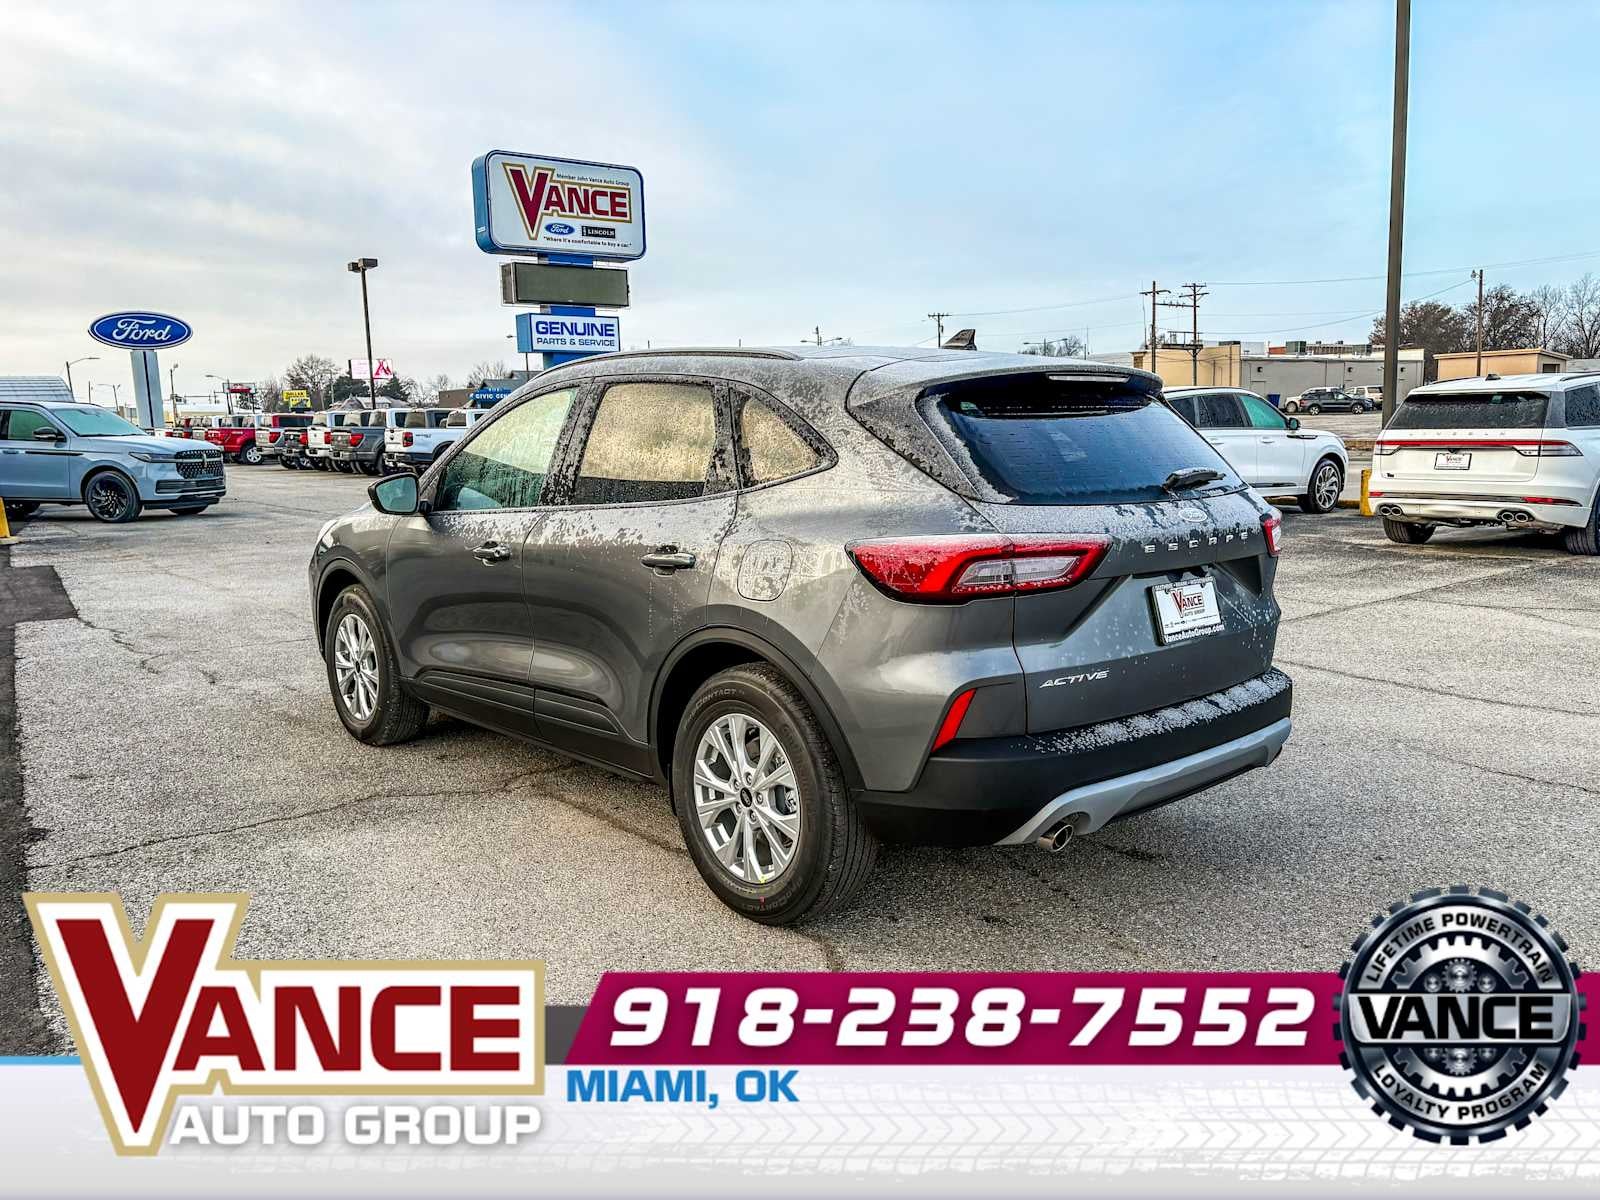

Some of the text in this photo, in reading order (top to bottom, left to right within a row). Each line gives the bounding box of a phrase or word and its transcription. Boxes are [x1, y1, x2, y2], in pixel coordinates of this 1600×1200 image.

[507, 167, 629, 235] VANCE
[550, 223, 569, 235] Ford
[587, 228, 615, 236] LINCOLN
[112, 318, 172, 341] Ford
[535, 320, 615, 337] GENUINE
[536, 337, 615, 347] PARTS & SERVICE
[1144, 531, 1249, 554] ESCAPE
[1171, 589, 1204, 617] VANCE
[1164, 624, 1225, 643] VanceAutoGroup.com
[1039, 670, 1110, 689] ACTIVE
